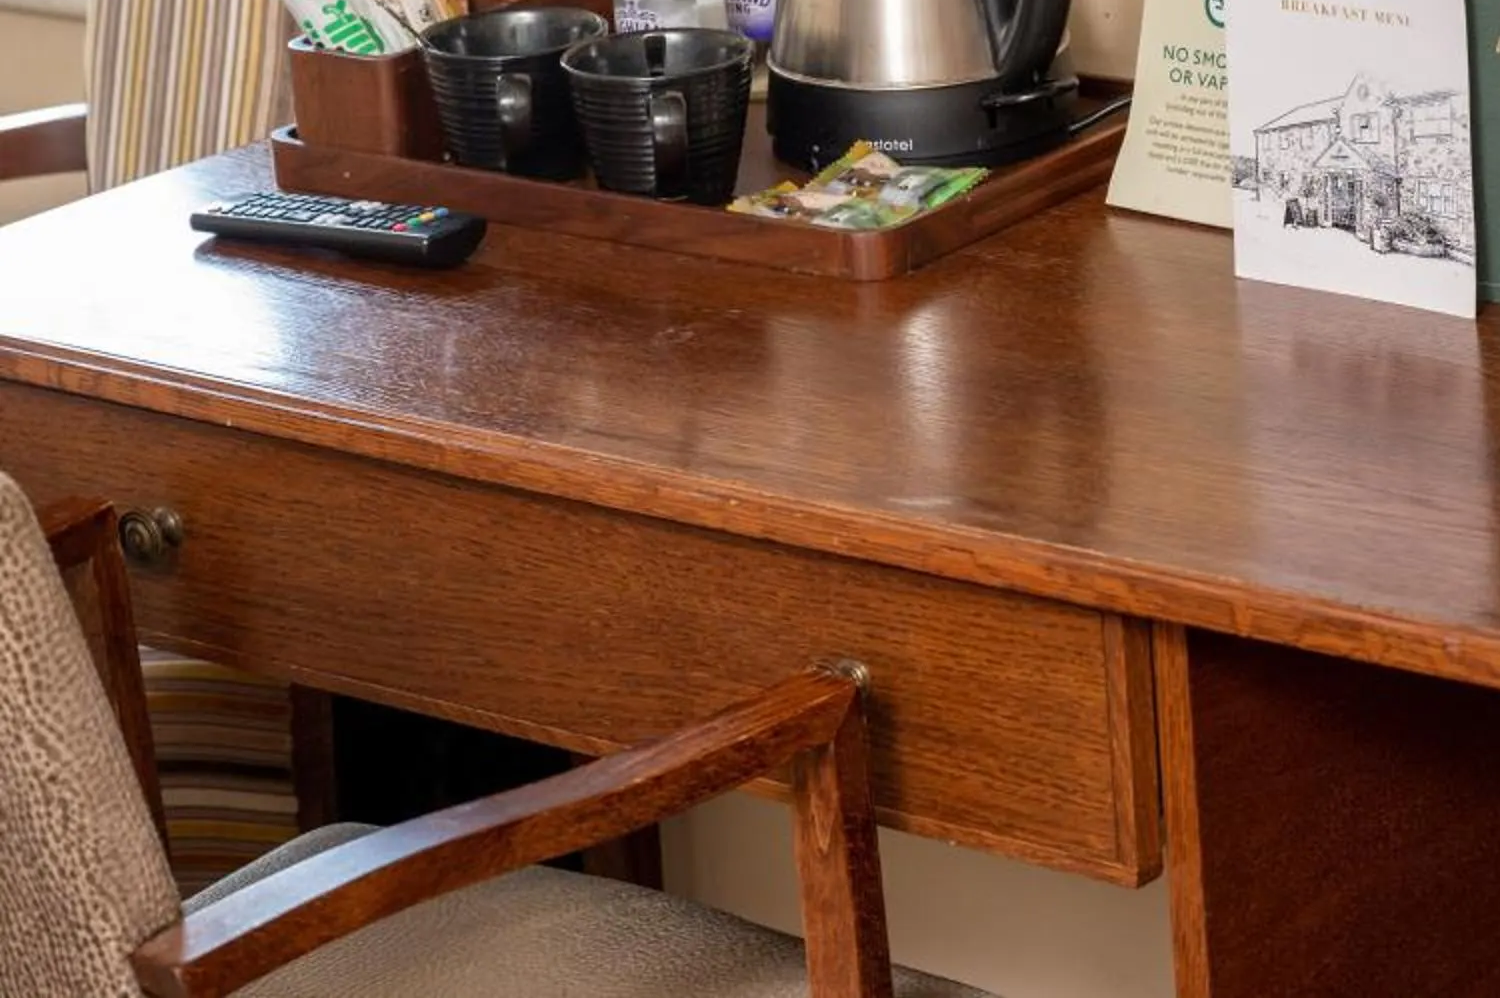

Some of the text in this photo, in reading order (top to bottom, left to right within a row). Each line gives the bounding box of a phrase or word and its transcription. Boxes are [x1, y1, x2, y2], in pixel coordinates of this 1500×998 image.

[1374, 10, 1412, 28] MENU
[1163, 45, 1189, 63] NO
[1169, 67, 1229, 90] OR VAP
